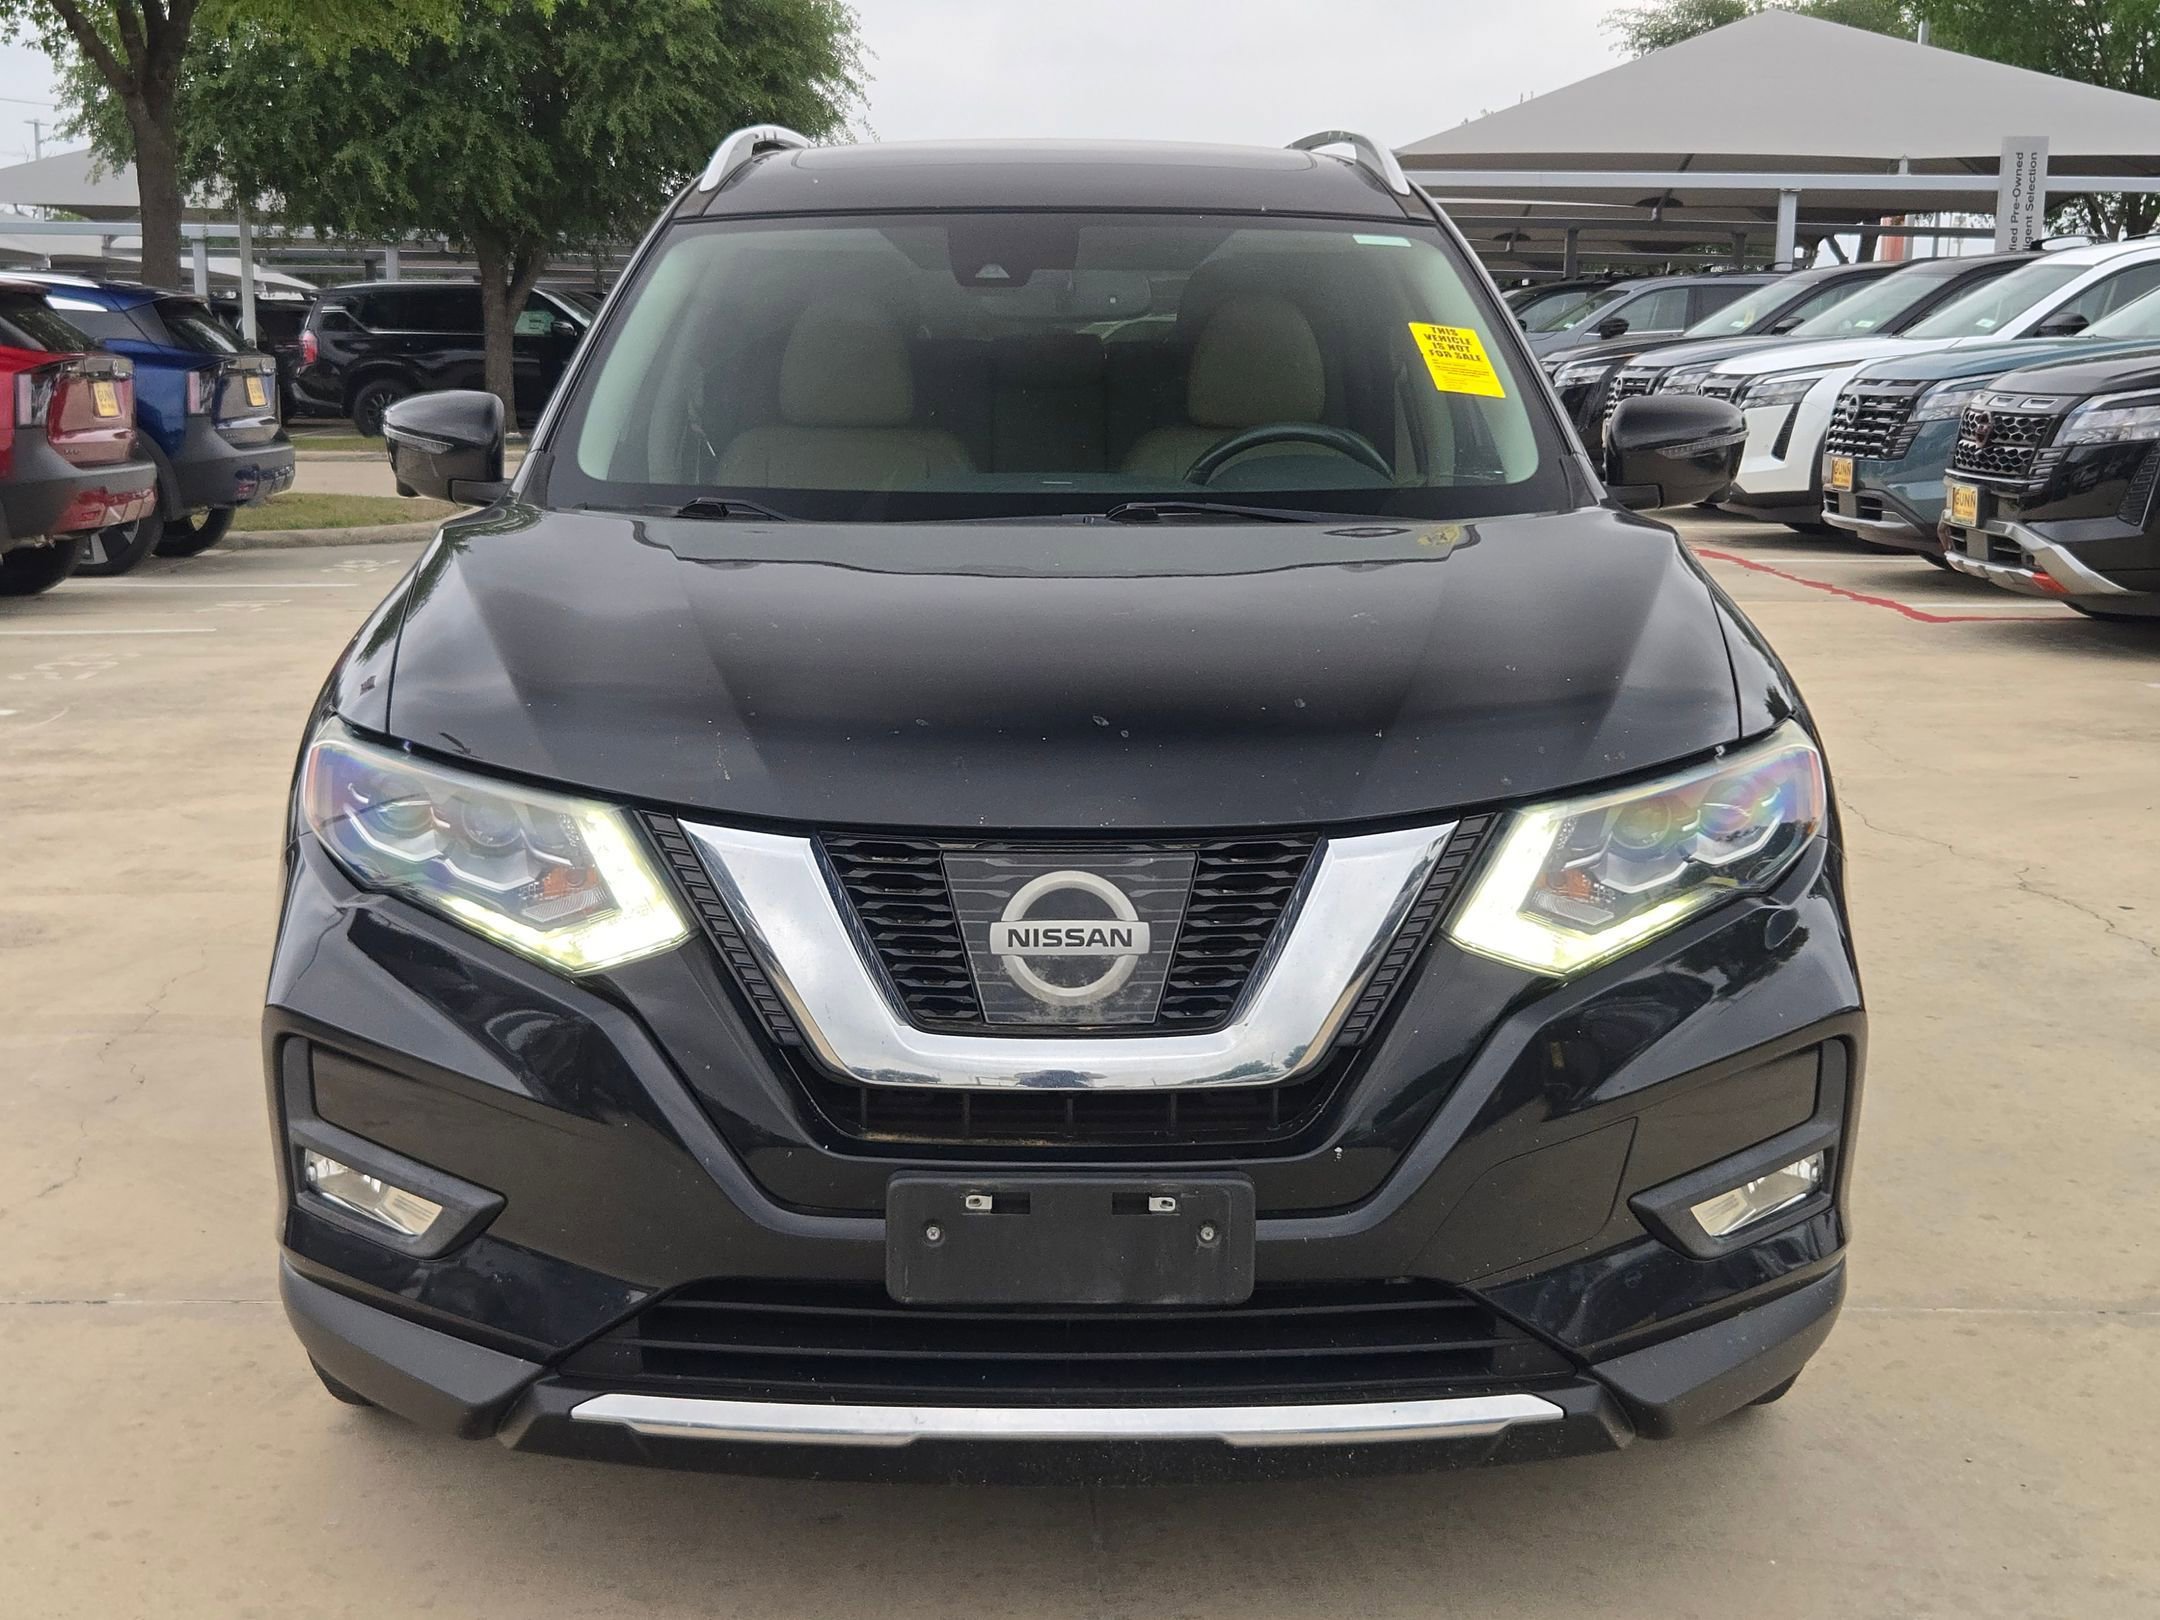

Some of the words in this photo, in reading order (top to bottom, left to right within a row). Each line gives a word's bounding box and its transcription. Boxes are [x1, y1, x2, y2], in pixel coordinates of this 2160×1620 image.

[2011, 152, 2024, 224] Pre-Owned
[2025, 152, 2038, 212] Selection
[1430, 326, 1458, 336] THIS
[1424, 333, 1472, 346] VEHICLE
[1432, 342, 1445, 350] IS
[1447, 344, 1471, 353] NOT
[1429, 349, 1452, 358] FOR
[1455, 352, 1483, 362] SALE
[1955, 490, 1976, 508] GUNN
[1008, 928, 1132, 947] NISSAN
